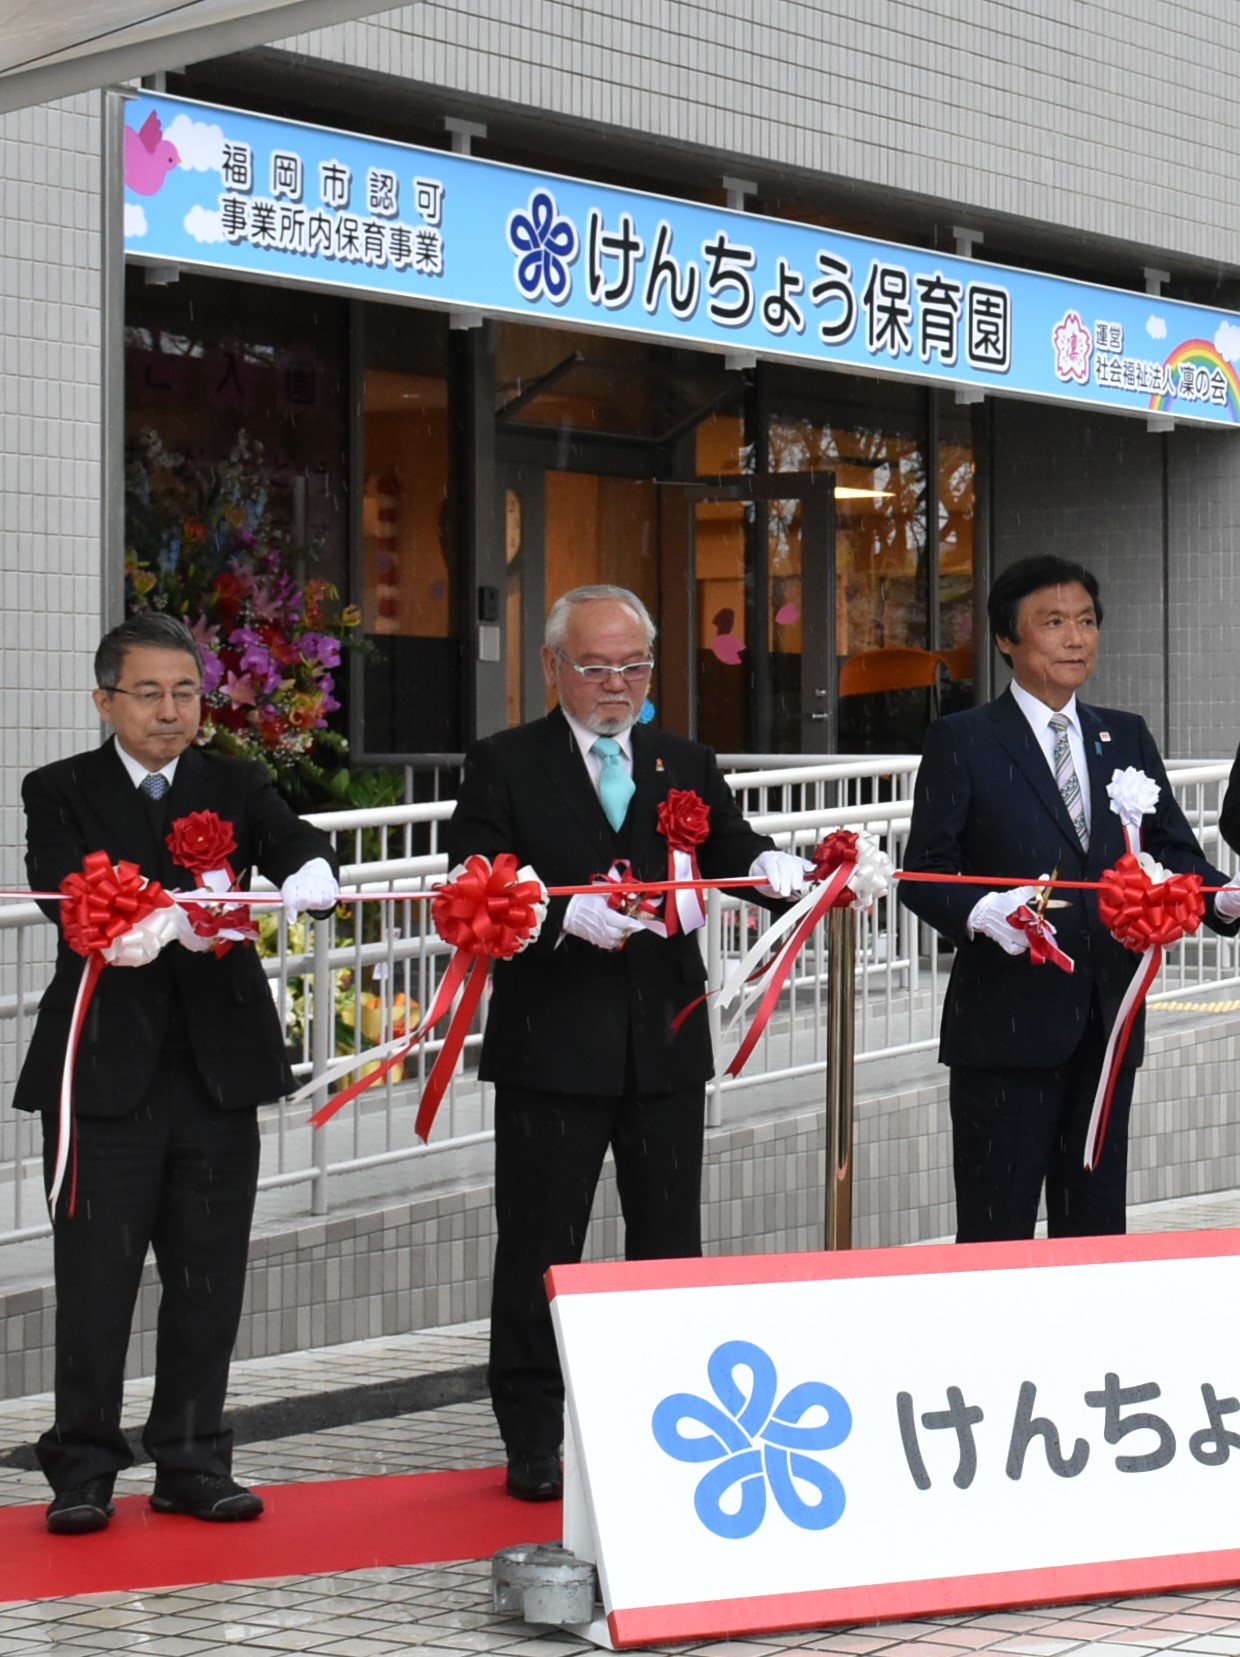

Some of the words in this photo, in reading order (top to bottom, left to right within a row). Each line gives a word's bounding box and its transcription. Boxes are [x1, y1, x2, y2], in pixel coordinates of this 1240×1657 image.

[222, 144, 440, 219] 福岡市認可
[222, 198, 439, 268] 事業所内保育事業
[588, 213, 1008, 365] けんちょう保育園
[1096, 323, 1122, 349] 運営
[1096, 356, 1175, 395] 社会福祉法人
